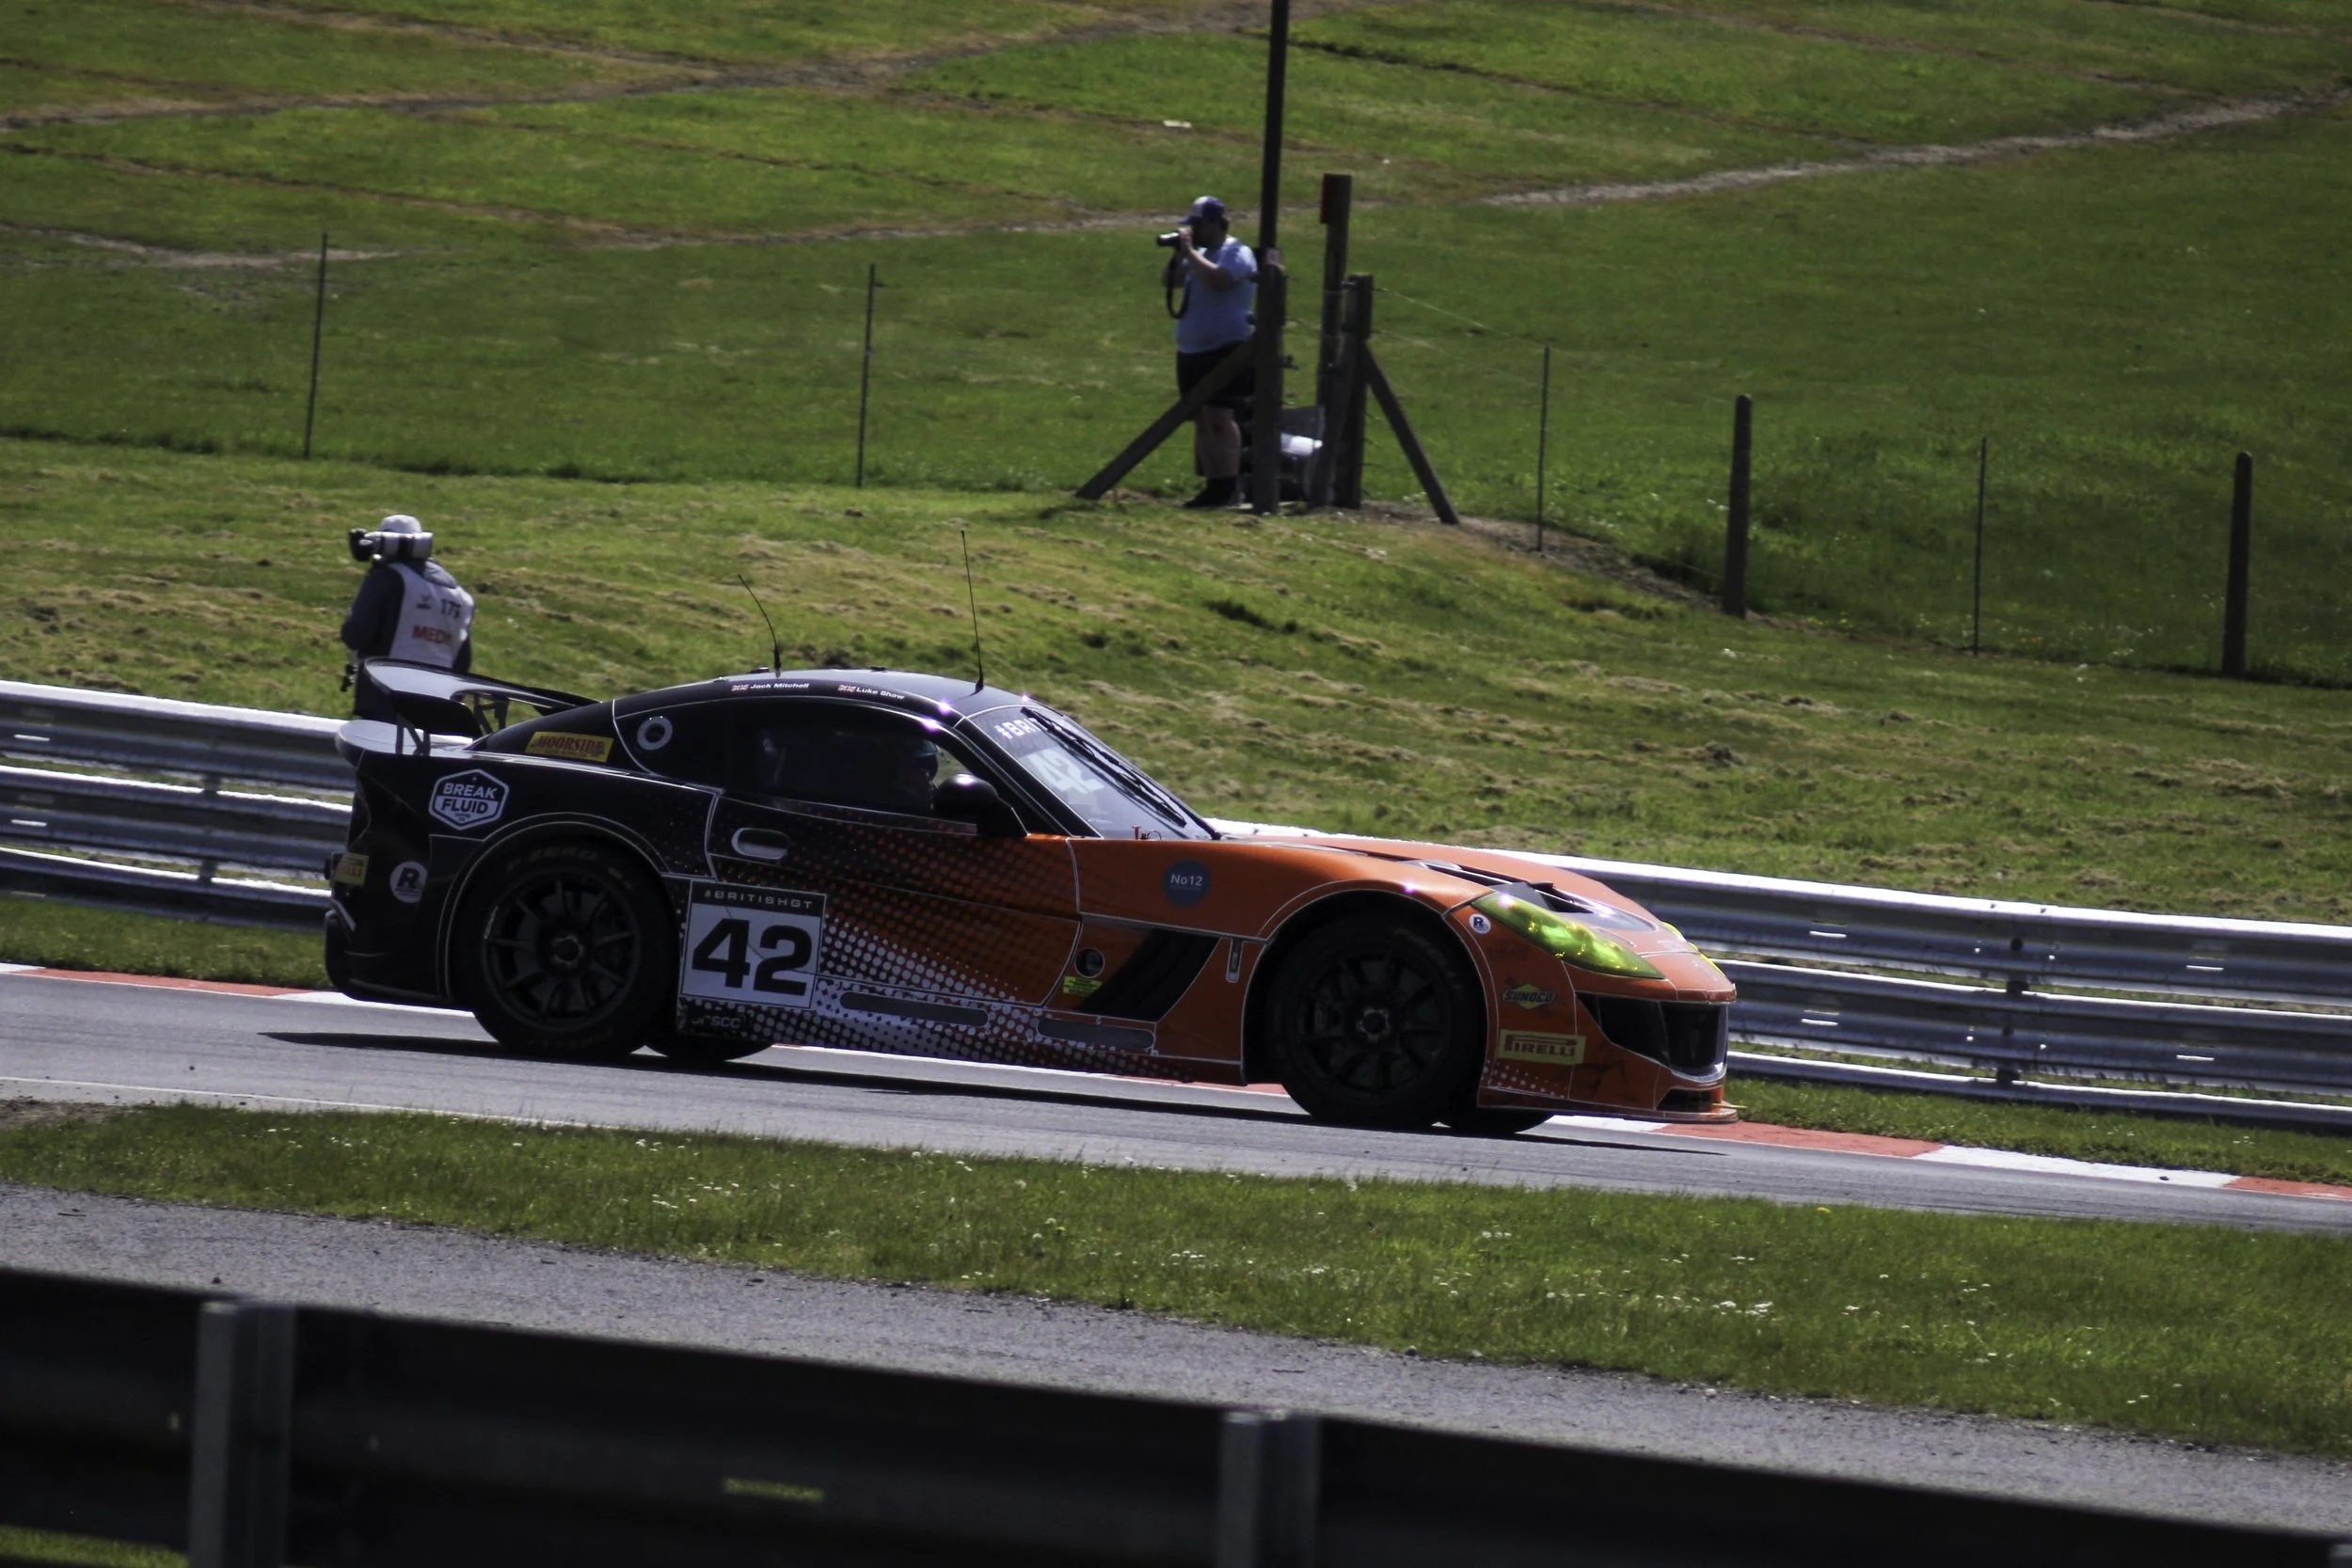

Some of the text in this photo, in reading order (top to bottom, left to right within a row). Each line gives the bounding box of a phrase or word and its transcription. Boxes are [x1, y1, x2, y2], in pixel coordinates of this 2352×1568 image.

[856, 687, 905, 700] Luke Shaw
[1027, 748, 1105, 794] 42
[443, 782, 497, 800] BREAK
[441, 798, 488, 815] FLUID
[1170, 873, 1204, 887] No12
[705, 890, 813, 910] #BRITISHGT
[691, 918, 812, 996] 42
[1504, 990, 1554, 1004] SUNOCO
[1504, 1035, 1578, 1056] PIRELLI
